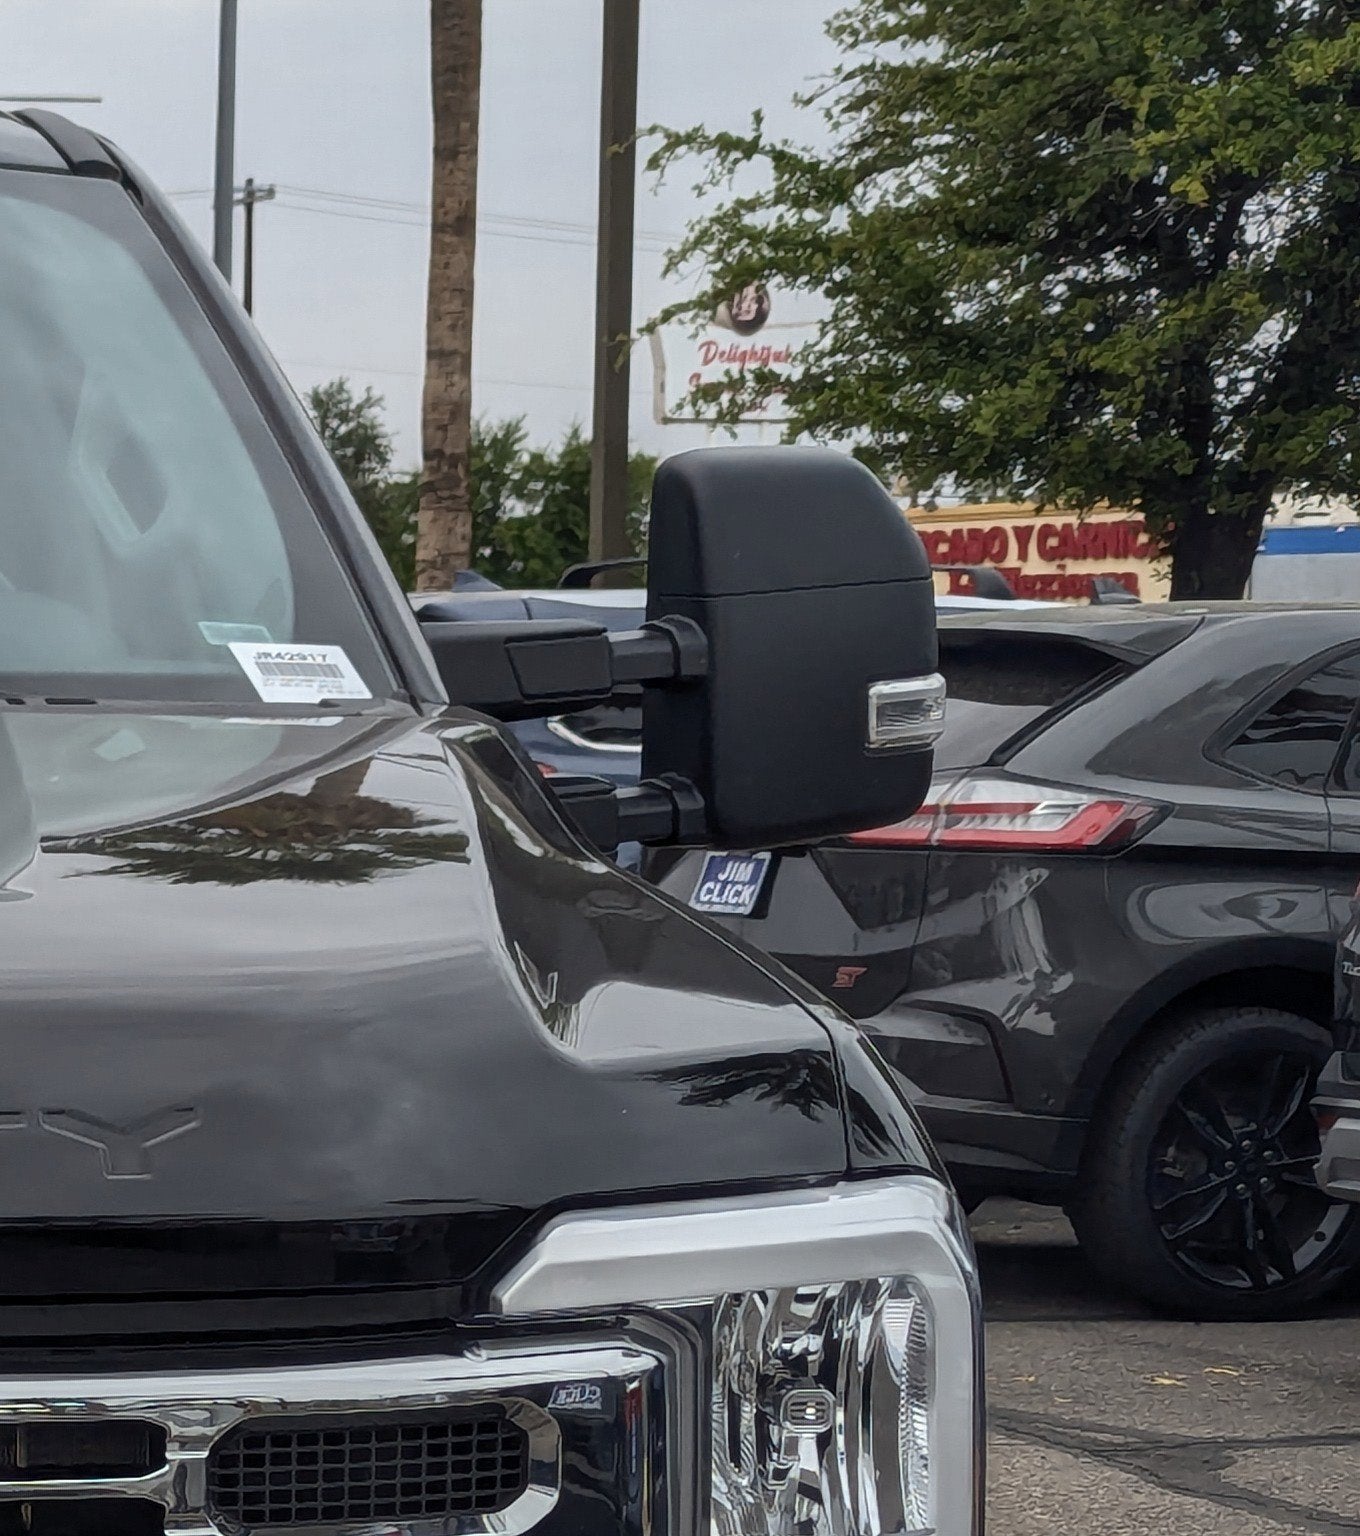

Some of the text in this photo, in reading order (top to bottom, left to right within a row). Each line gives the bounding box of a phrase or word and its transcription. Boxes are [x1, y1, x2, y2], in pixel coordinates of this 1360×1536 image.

[1012, 525, 1034, 562] Y
[1037, 520, 1162, 562] CARNIC
[717, 860, 757, 881] JIM
[699, 881, 757, 905] CLICK
[832, 966, 867, 987] ST
